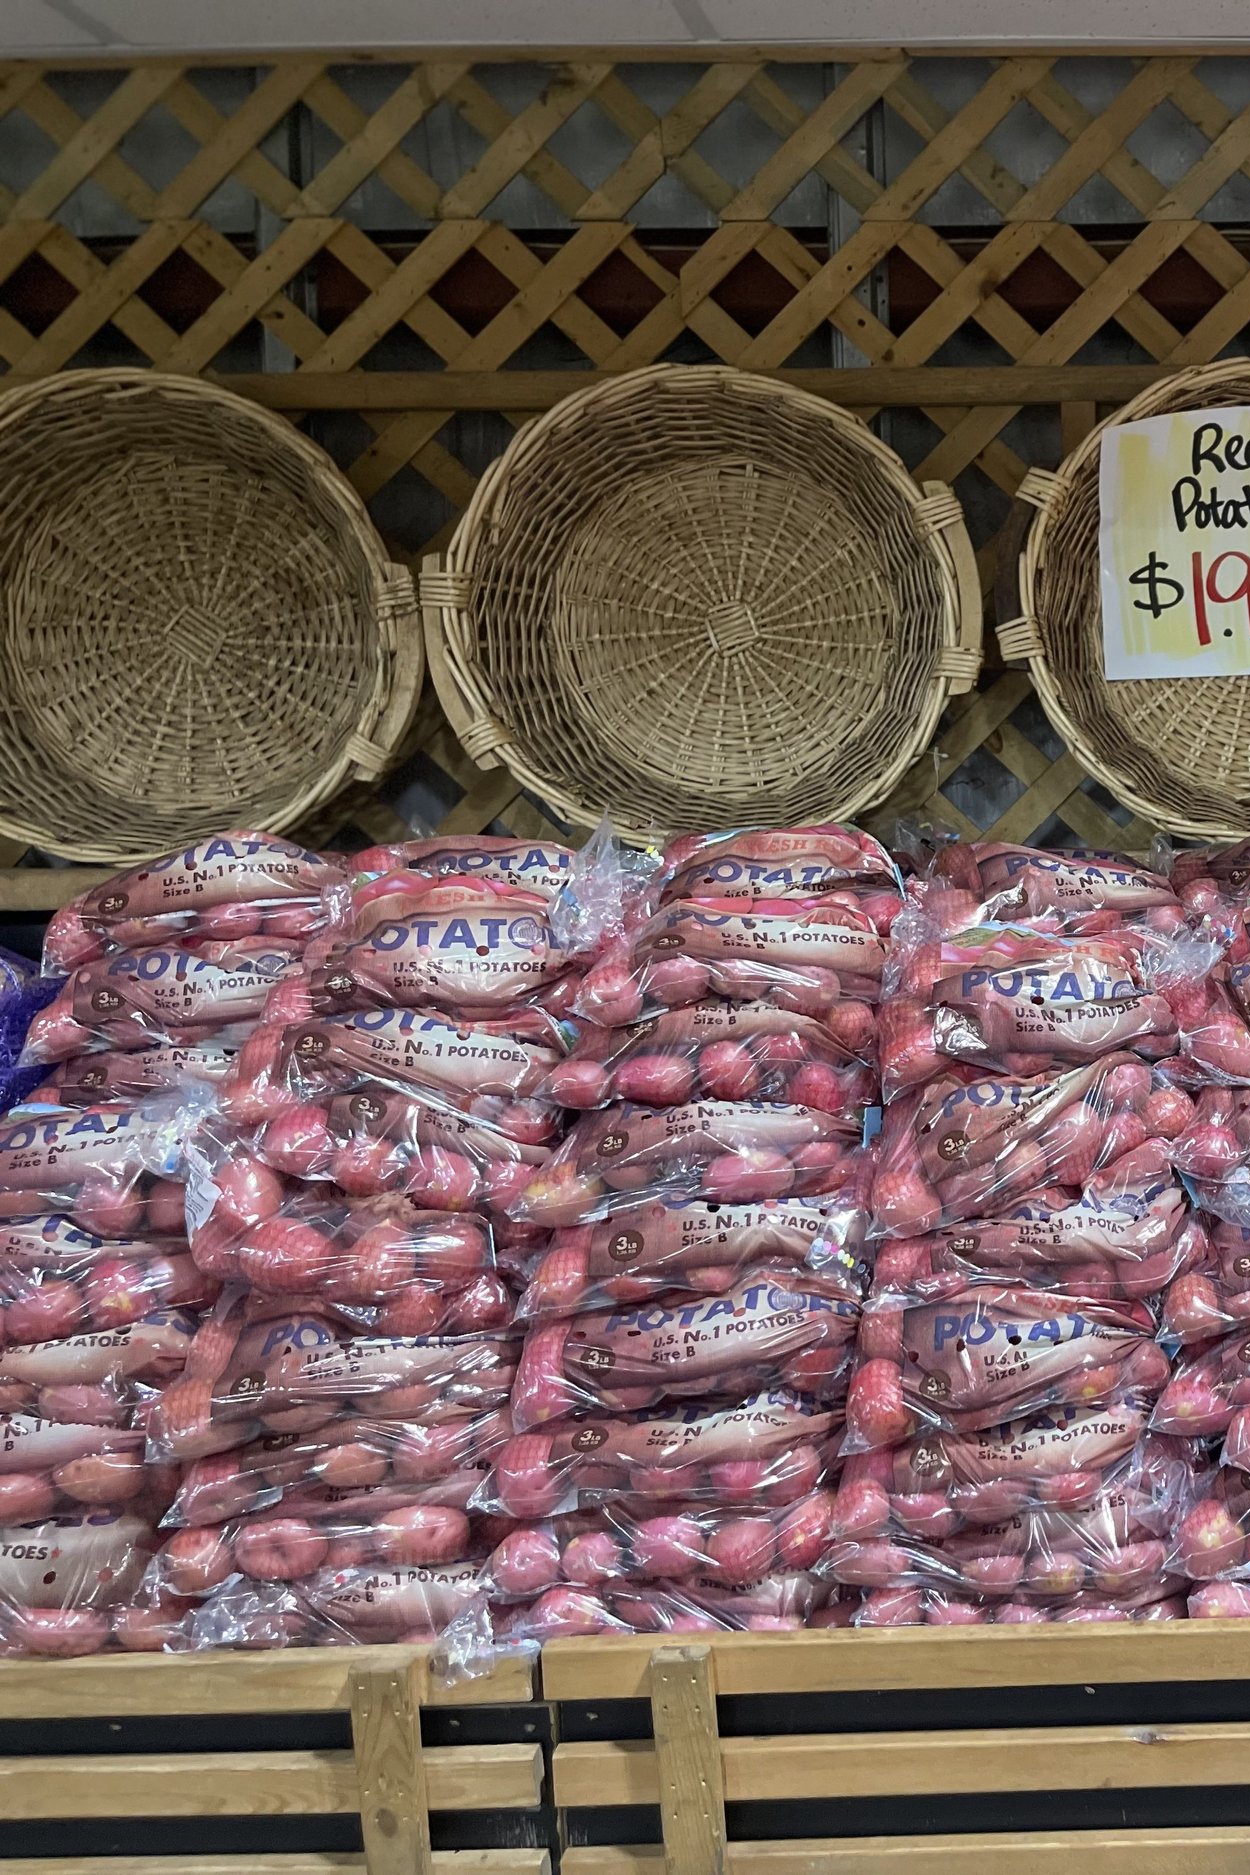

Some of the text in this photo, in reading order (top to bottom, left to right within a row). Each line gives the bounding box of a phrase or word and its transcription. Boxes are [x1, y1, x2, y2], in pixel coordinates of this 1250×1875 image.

[163, 878, 189, 887] U.S.
[229, 863, 299, 874] POTATOES
[162, 884, 204, 897] Size B
[793, 933, 865, 946] POTATOES
[469, 961, 547, 973] POTATOES
[394, 977, 424, 987] Size
[154, 997, 192, 1009] Size B
[1015, 1007, 1040, 1019] U.S.
[1078, 998, 1141, 1019] POTATOES
[694, 1014, 737, 1025] Size B
[1015, 1021, 1044, 1033] Size
[371, 1039, 399, 1052] U.S.
[448, 1046, 529, 1063] POTATOES
[404, 1056, 414, 1067] B
[423, 1114, 452, 1133] Size
[457, 1122, 467, 1134] B
[666, 1112, 693, 1123] U.S.
[665, 1119, 711, 1136] Size B
[9, 1155, 58, 1170] Size B
[683, 1219, 711, 1231] U.S.
[718, 1232, 728, 1243] B
[1052, 1235, 1062, 1244] B
[653, 1333, 679, 1348] U.S.
[726, 1312, 805, 1335] POTATOES
[651, 1346, 696, 1362] Size B
[986, 1368, 1016, 1382] Size
[1051, 1423, 1126, 1442] POTATOES
[366, 1592, 375, 1602] B
